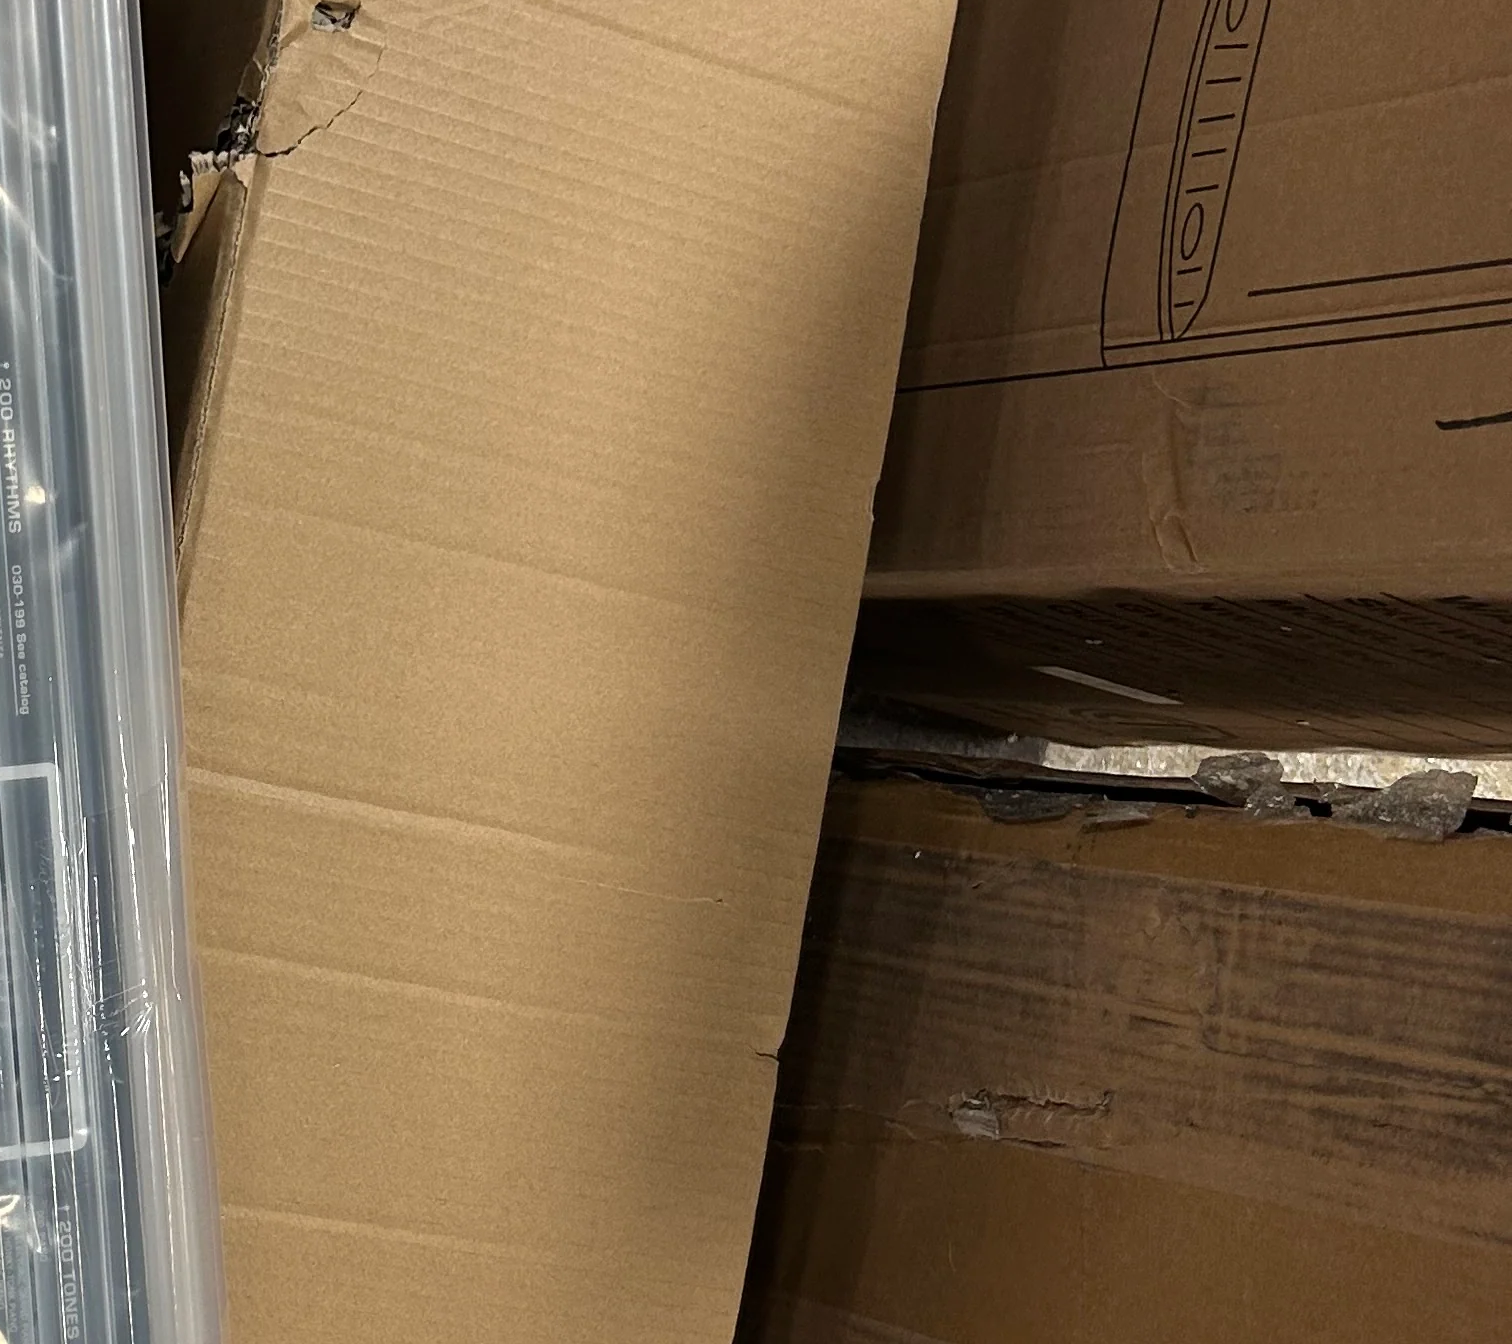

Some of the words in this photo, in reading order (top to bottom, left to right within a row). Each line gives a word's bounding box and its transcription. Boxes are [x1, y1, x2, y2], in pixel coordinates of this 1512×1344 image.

[0, 428, 21, 535] RHYTHMS
[9, 564, 25, 629] 030-199
[14, 633, 27, 660] See
[15, 662, 31, 715] catalog
[57, 1220, 74, 1263] 200
[61, 1271, 79, 1340] TONES
